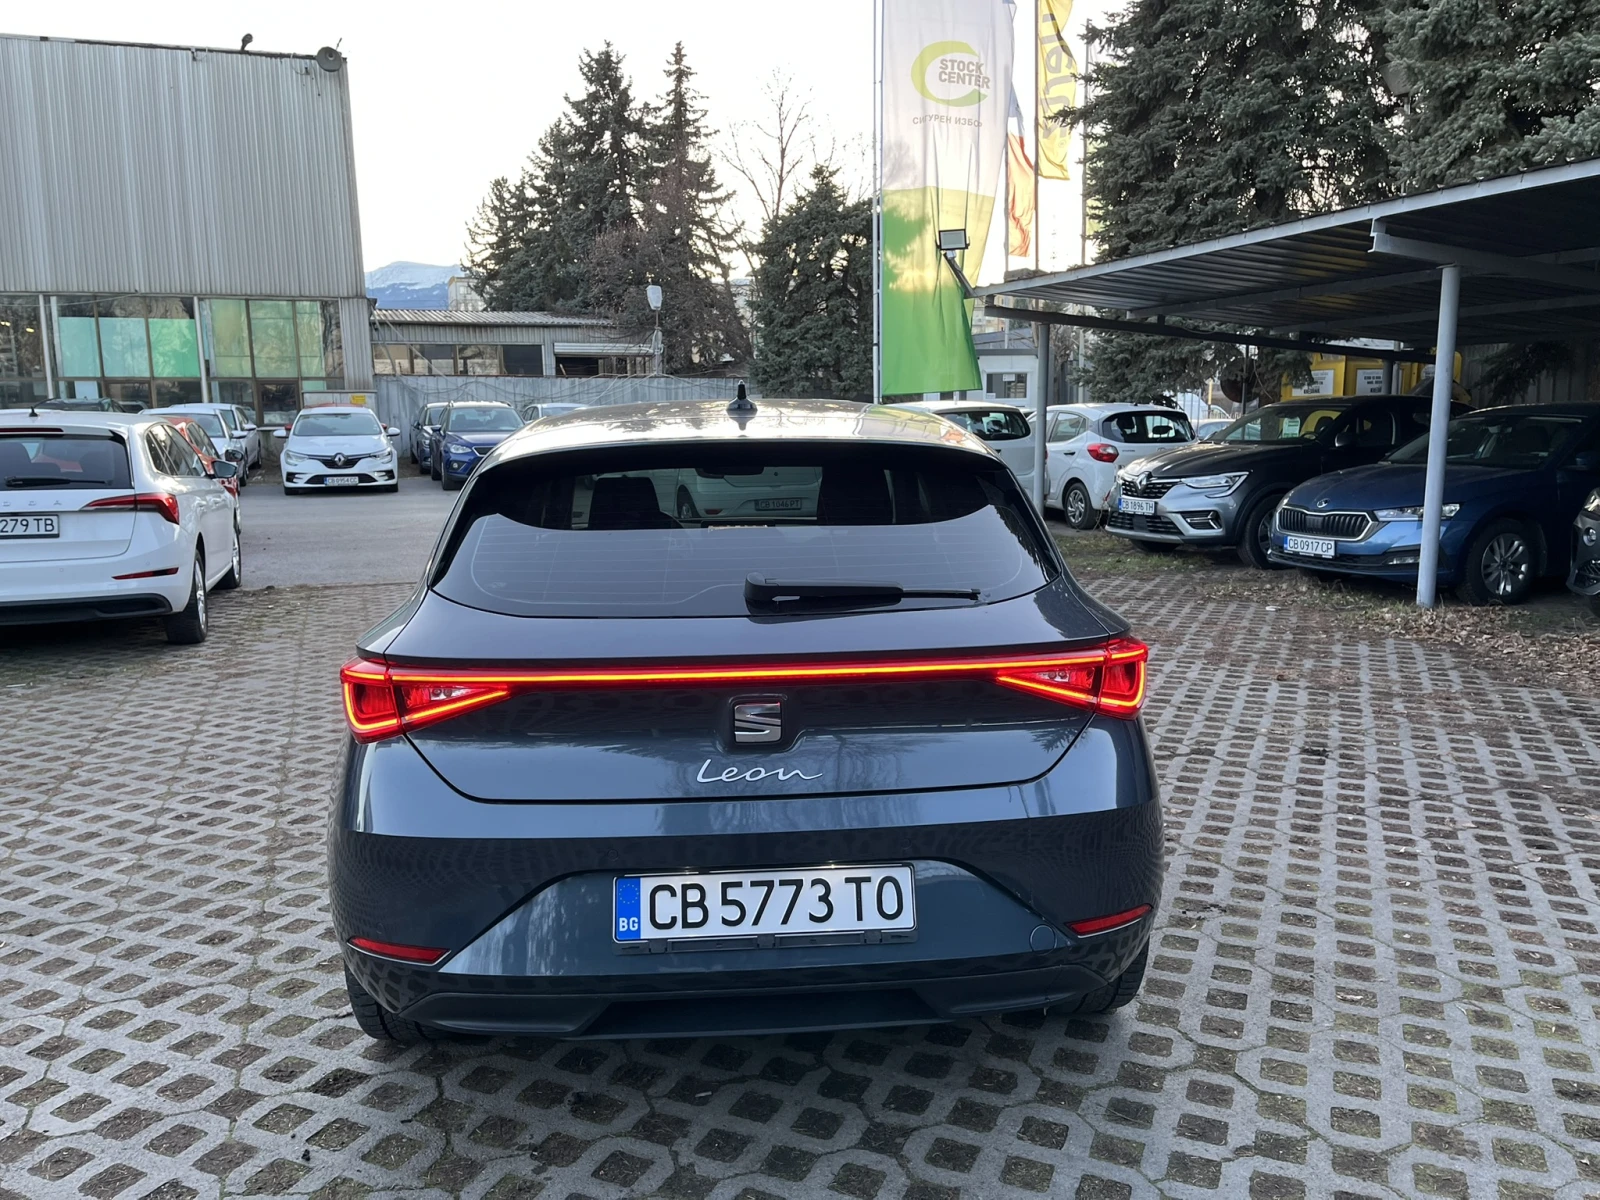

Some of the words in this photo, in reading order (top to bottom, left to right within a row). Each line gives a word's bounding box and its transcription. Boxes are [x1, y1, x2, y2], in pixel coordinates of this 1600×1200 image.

[939, 58, 985, 75] STOCK
[938, 70, 991, 89] CENTER
[912, 114, 952, 125] СИГУРЕН
[1120, 498, 1131, 510] CB
[1131, 500, 1145, 511] 1896
[1145, 502, 1154, 513] TH
[33, 518, 55, 532] TB
[1288, 538, 1300, 549] CB
[1300, 539, 1320, 551] 0917
[1321, 541, 1333, 553] CP
[696, 758, 823, 783] Leon
[618, 917, 638, 931] BG
[648, 881, 709, 930] CB
[721, 878, 834, 926] 5773
[844, 875, 904, 921] TO
